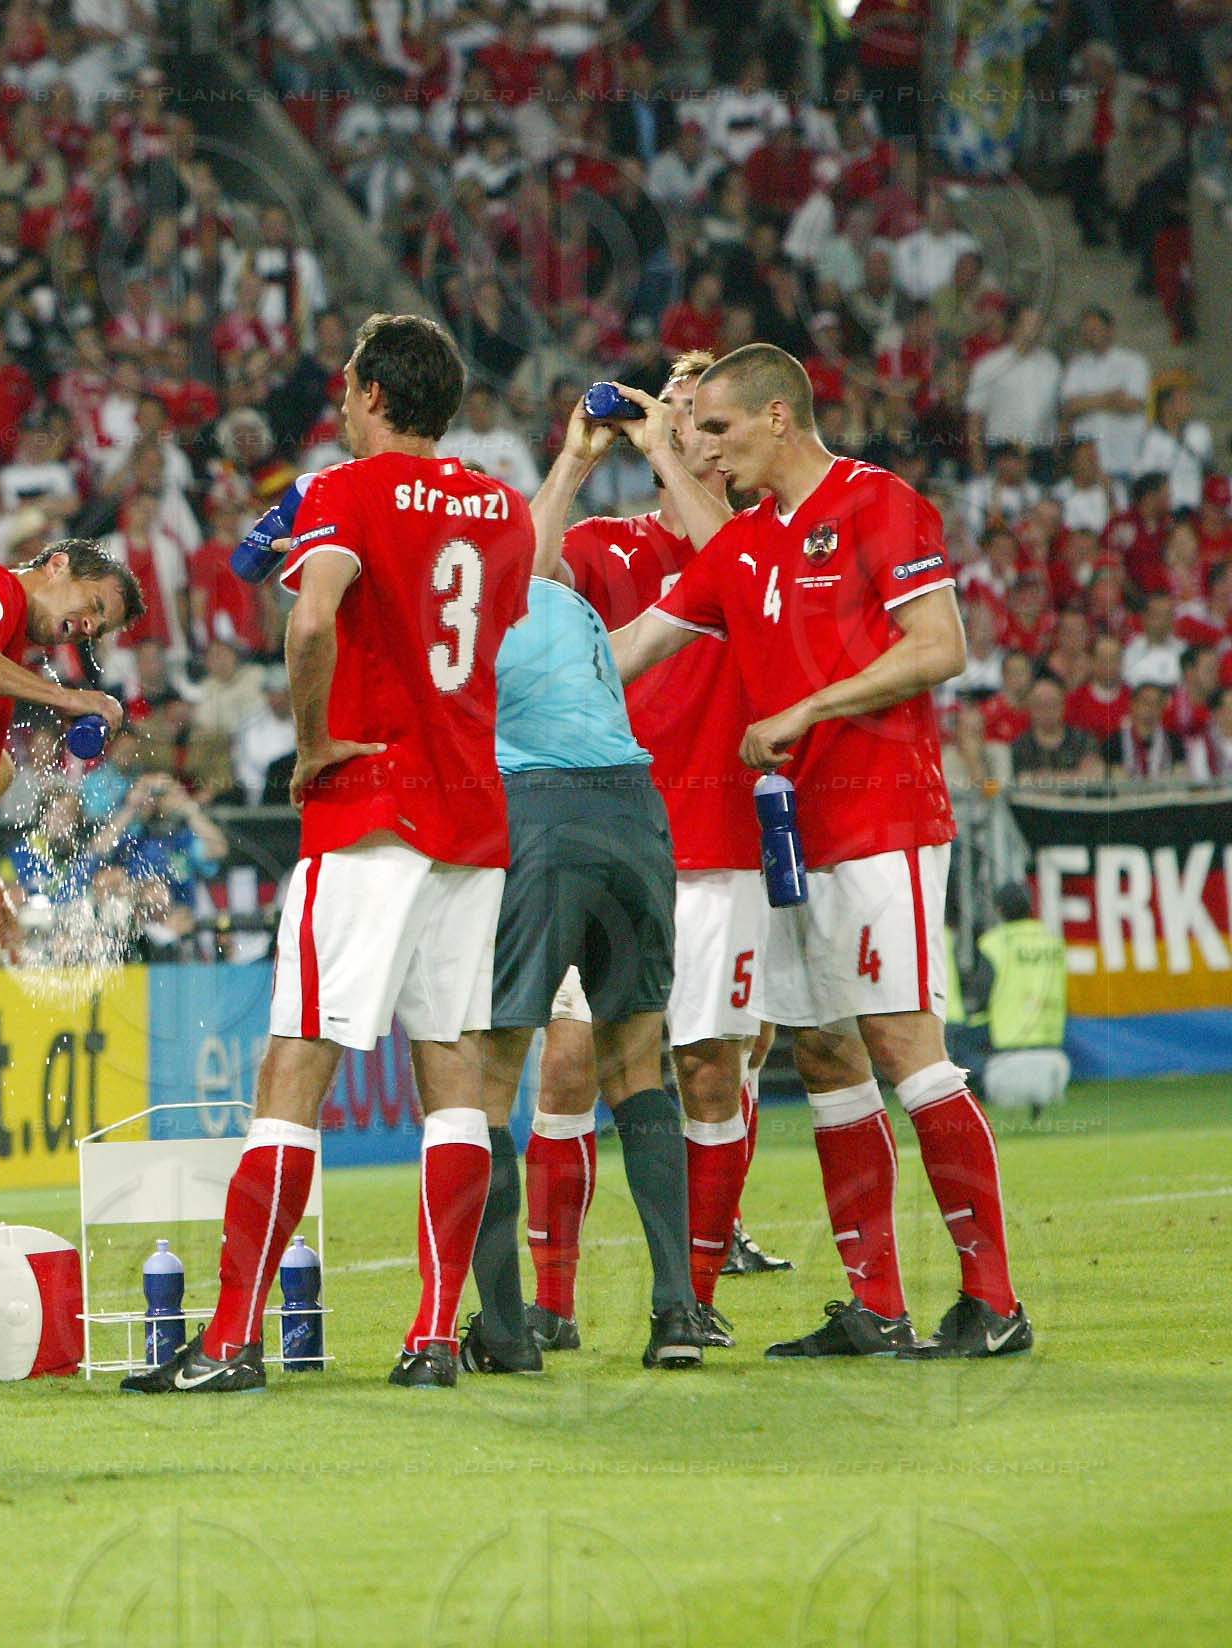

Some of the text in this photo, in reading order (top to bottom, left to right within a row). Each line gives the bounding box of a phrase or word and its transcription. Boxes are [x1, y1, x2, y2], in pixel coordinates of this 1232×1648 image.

[300, 525, 336, 542] RESPECT
[429, 538, 483, 692] 3
[764, 553, 782, 624] 4
[1038, 841, 1232, 976] ERK
[730, 950, 754, 1008] 5
[857, 925, 882, 984] 4
